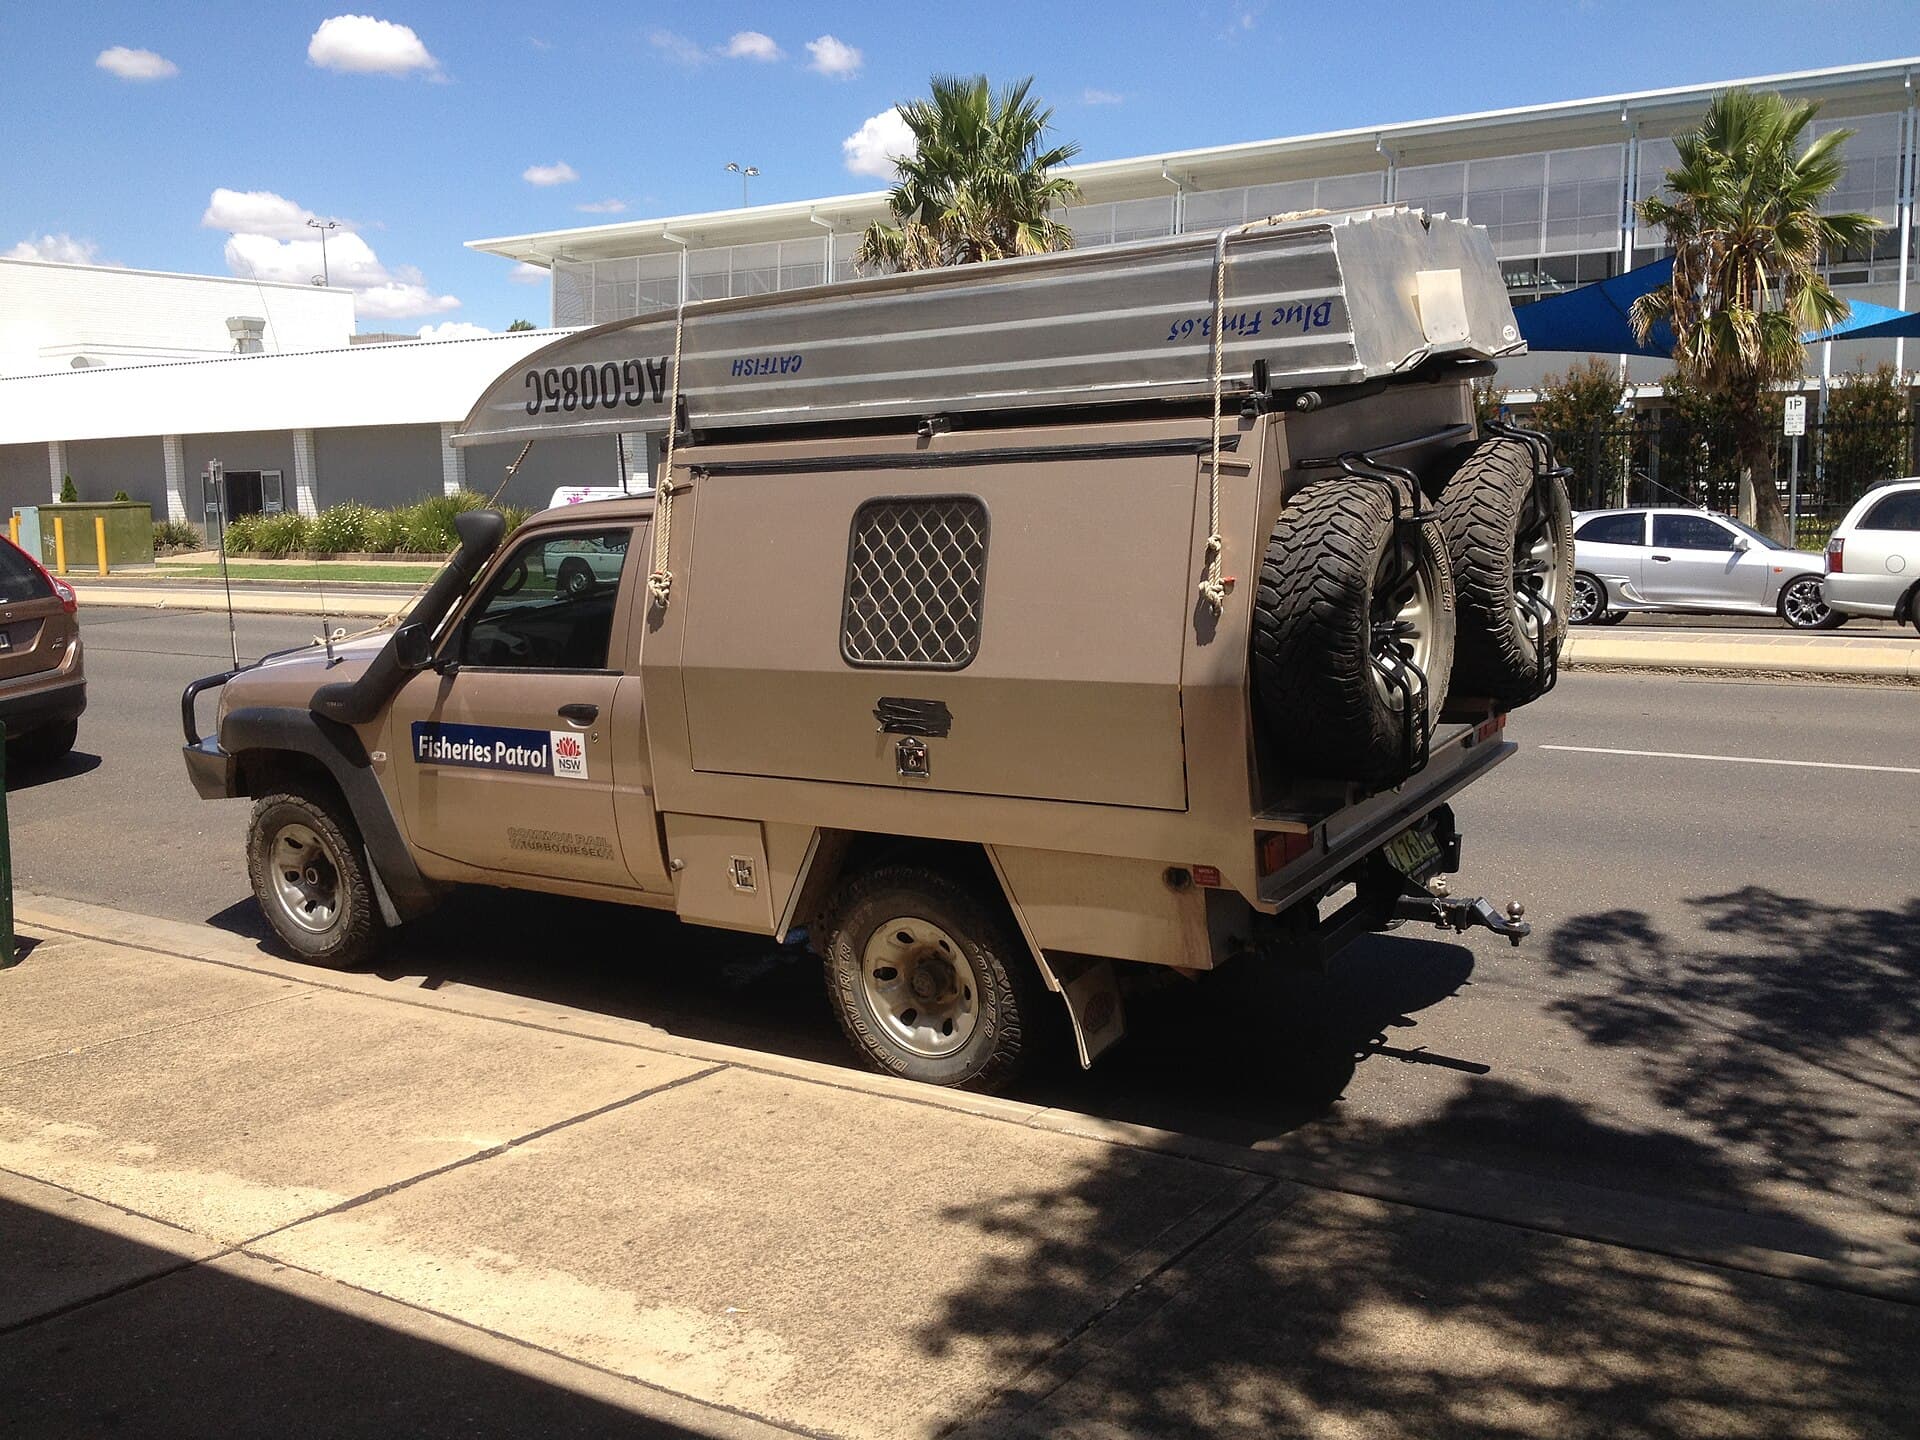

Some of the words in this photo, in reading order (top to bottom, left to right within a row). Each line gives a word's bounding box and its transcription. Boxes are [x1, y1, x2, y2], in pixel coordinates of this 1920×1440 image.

[1167, 314, 1214, 343] 3.65
[1221, 311, 1262, 336] Fin
[1271, 302, 1332, 332] Blue
[732, 355, 802, 377] CATFISH
[1789, 399, 1802, 410] 1P
[419, 735, 492, 764] Fisheries
[495, 741, 547, 768] Patrol
[559, 759, 581, 770] NSW
